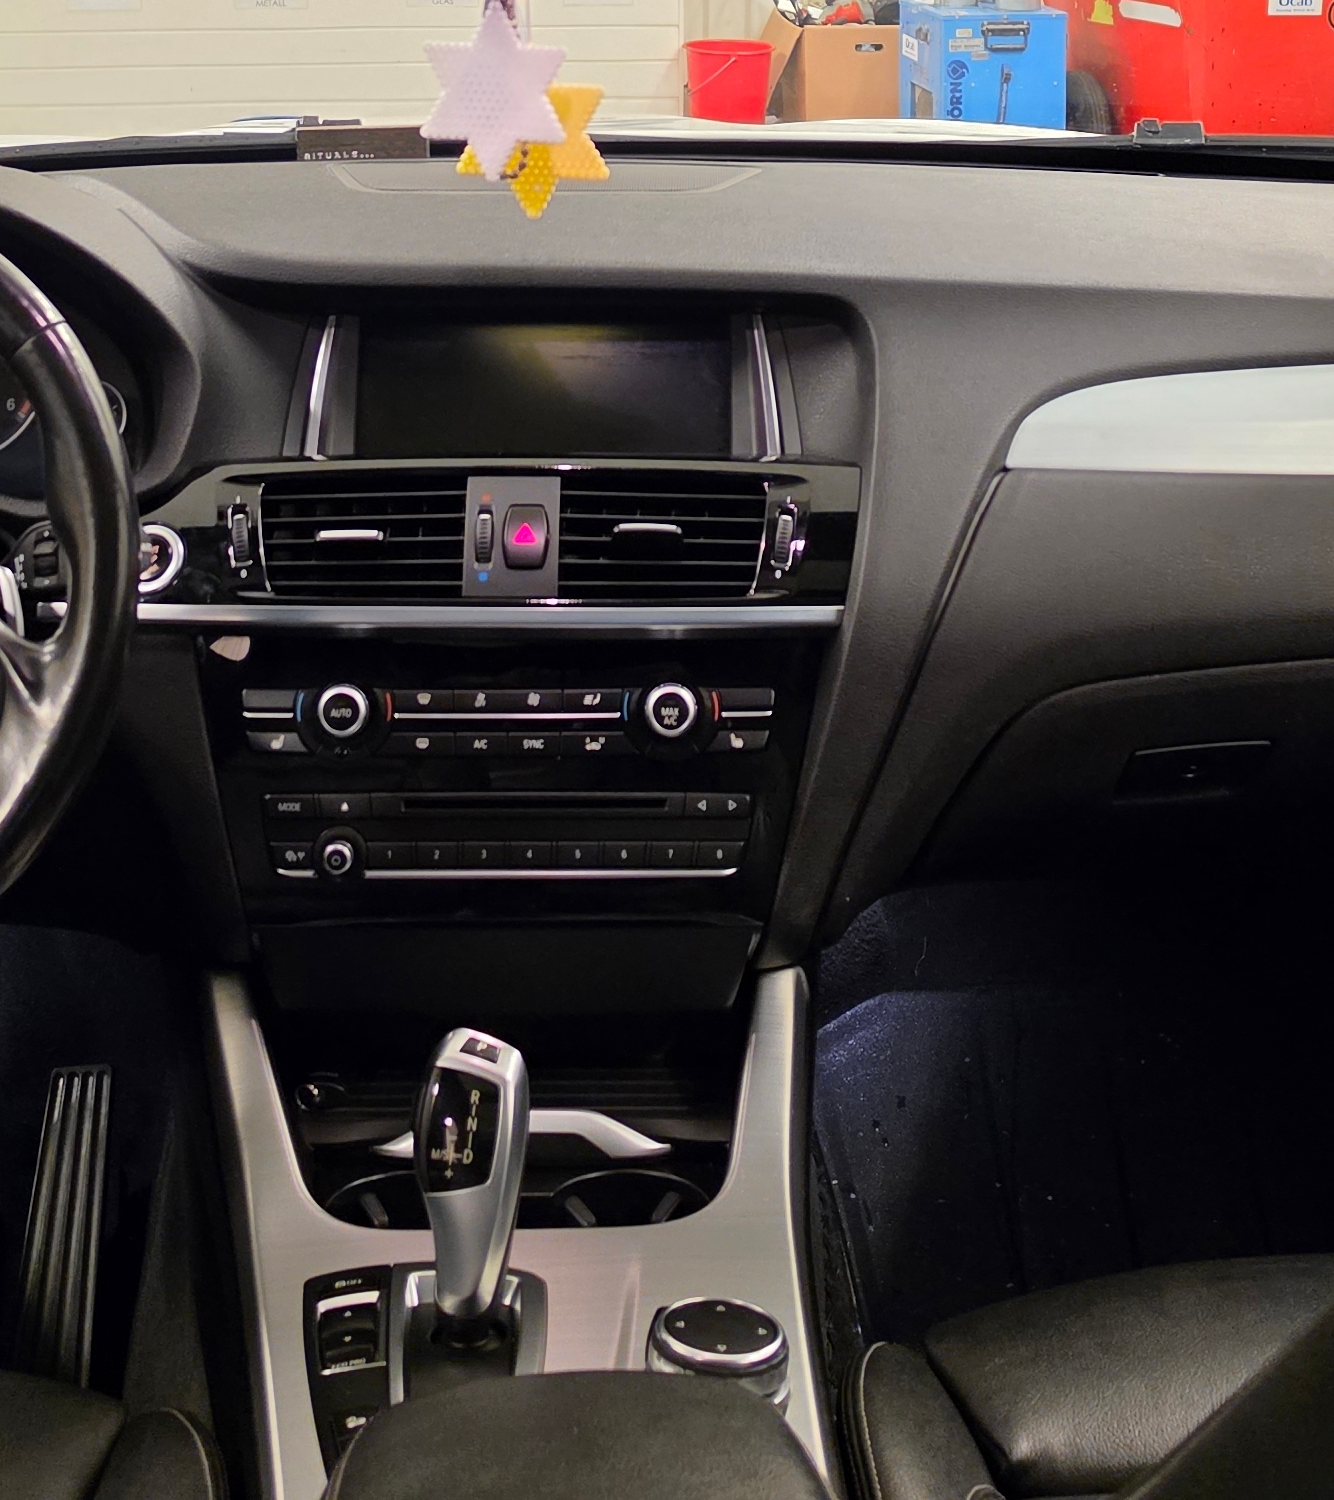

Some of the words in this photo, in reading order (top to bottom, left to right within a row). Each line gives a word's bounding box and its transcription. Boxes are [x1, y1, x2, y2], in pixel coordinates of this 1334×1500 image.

[255, 0, 287, 7] METALL
[947, 81, 963, 120] ÖRN
[6, 398, 16, 411] 6
[330, 707, 352, 718] AUTO
[473, 738, 488, 750] A/C
[523, 738, 545, 750] SYNC
[434, 849, 440, 860] 2
[481, 849, 487, 859] 3
[526, 849, 533, 859] 4
[668, 849, 674, 859] 7
[470, 1089, 480, 1105] R
[467, 1116, 478, 1131] N
[463, 1148, 473, 1165] D
